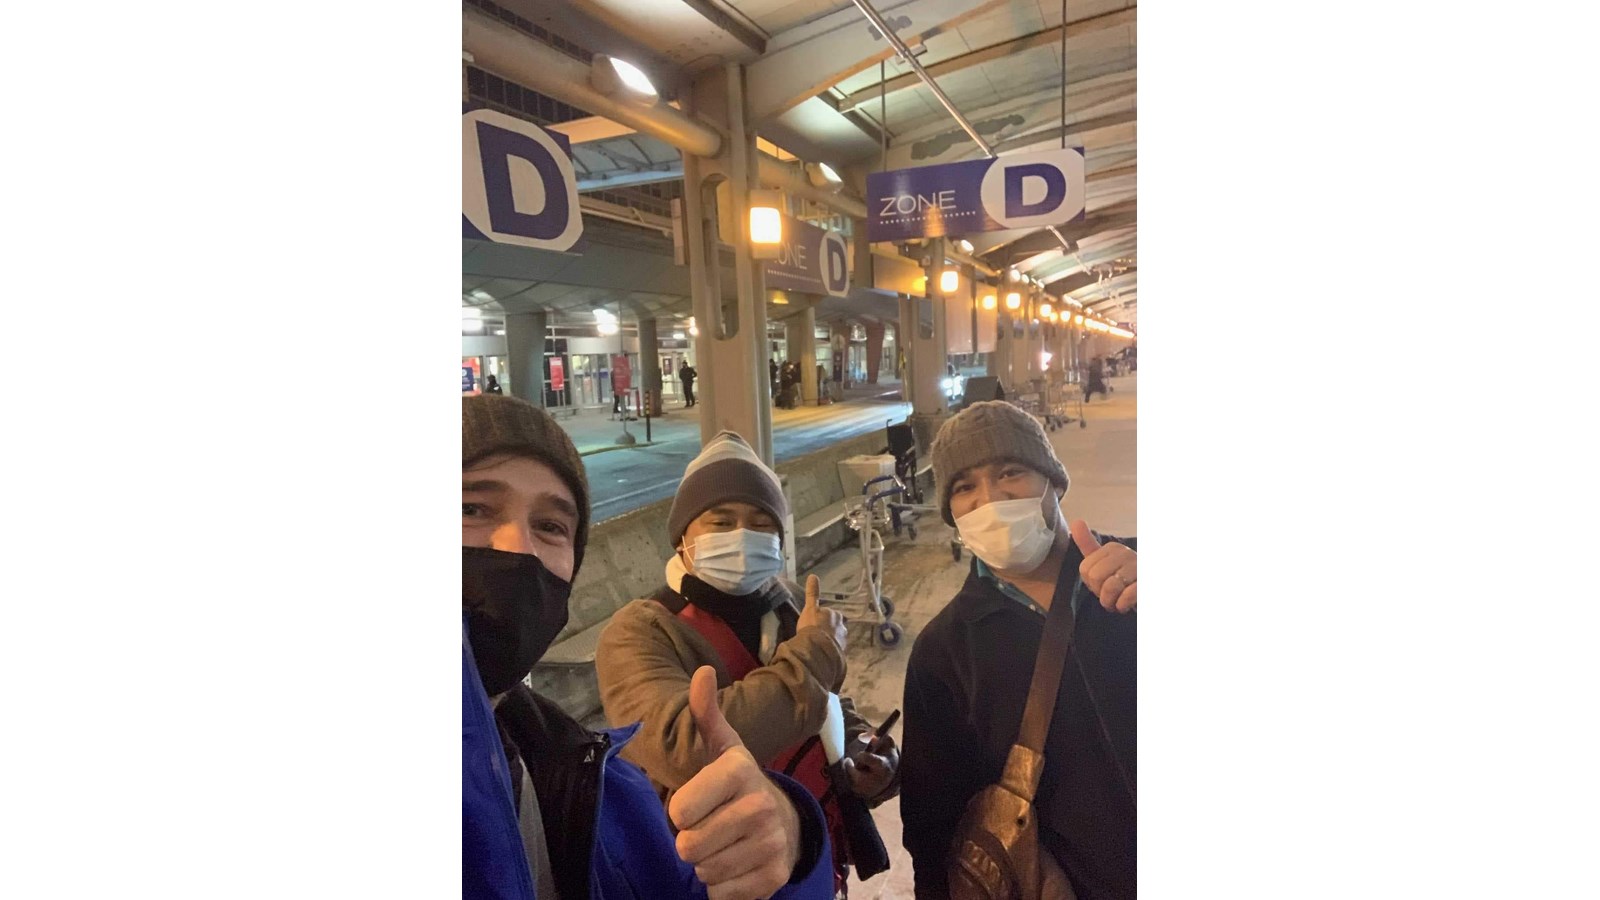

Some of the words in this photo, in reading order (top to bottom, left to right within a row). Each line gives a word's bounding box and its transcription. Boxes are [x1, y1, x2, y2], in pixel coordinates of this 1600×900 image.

[475, 119, 569, 240] D
[879, 189, 957, 217] ZONE
[1004, 163, 1067, 218] D
[773, 241, 808, 271] ONE
[826, 238, 847, 292] D
